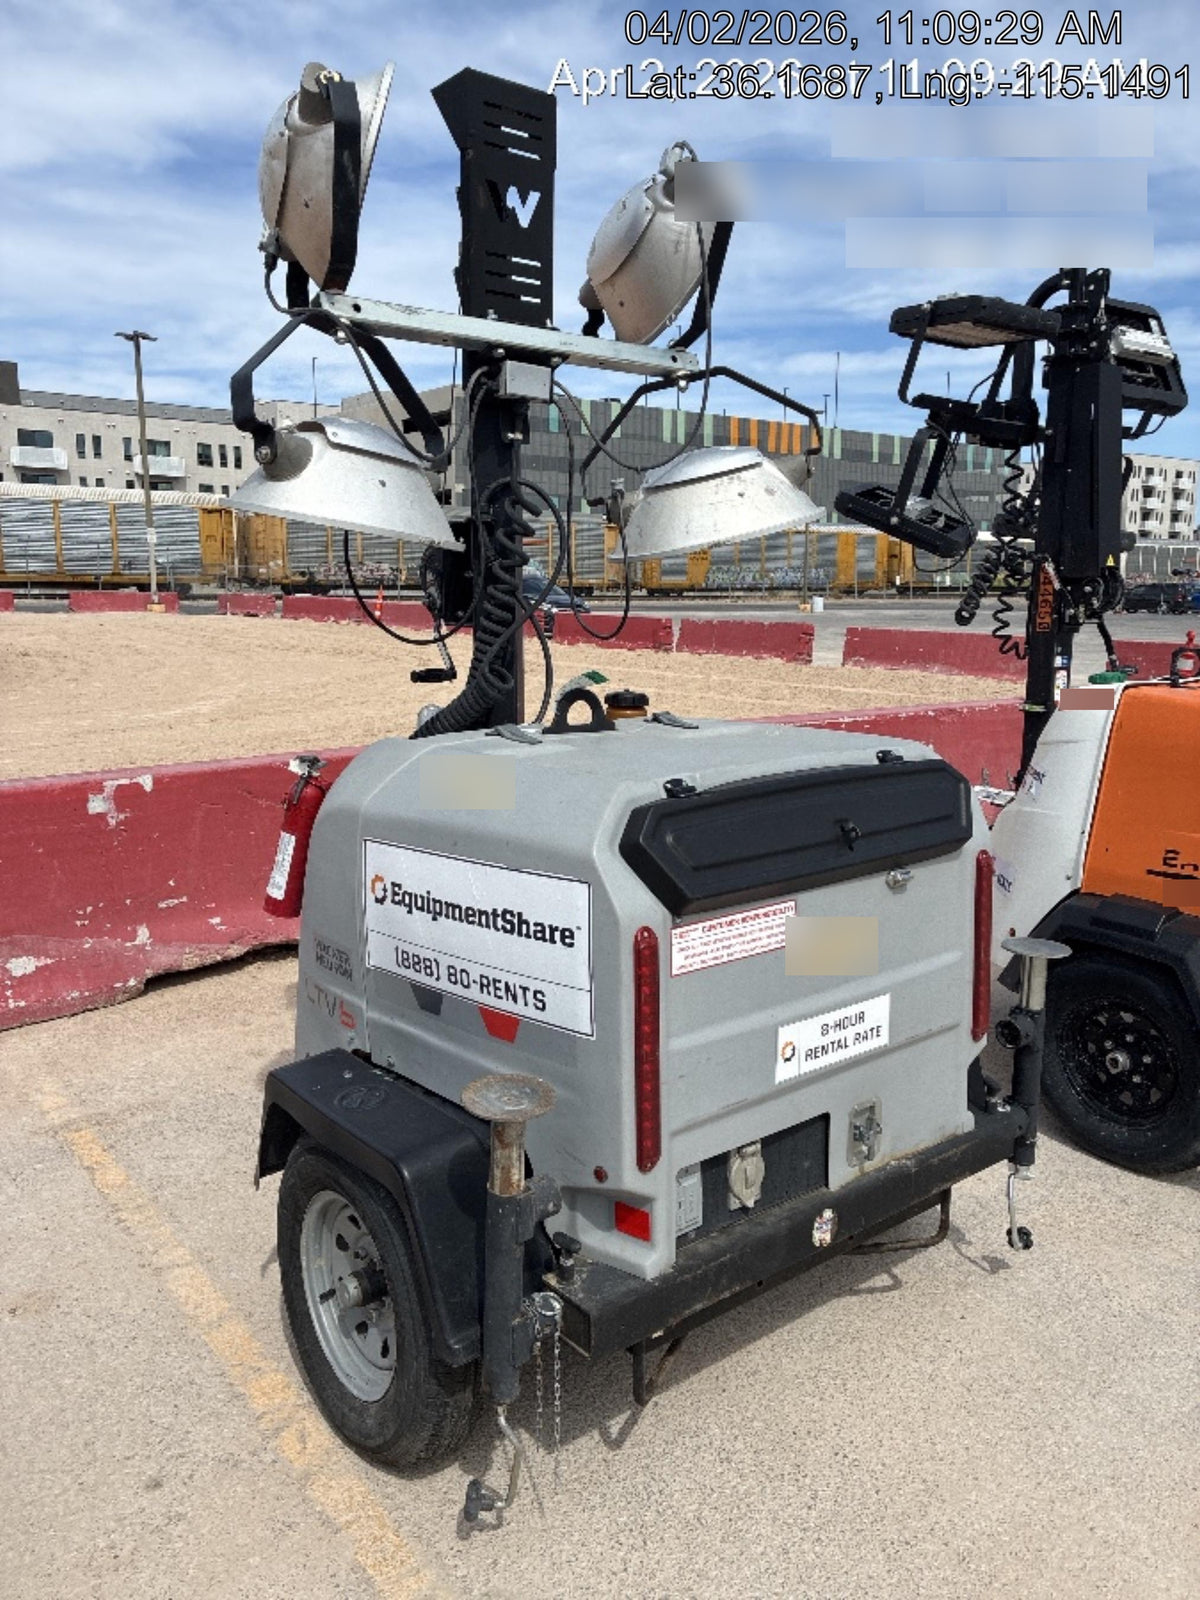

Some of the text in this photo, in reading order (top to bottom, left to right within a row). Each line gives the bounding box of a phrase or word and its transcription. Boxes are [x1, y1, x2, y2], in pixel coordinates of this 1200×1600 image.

[390, 881, 576, 948] EquipmentShare
[395, 946, 547, 1012] (888) 80-RENTS
[804, 1025, 882, 1062] RENTAL RATE
[821, 1011, 865, 1037] 8-HOUR
